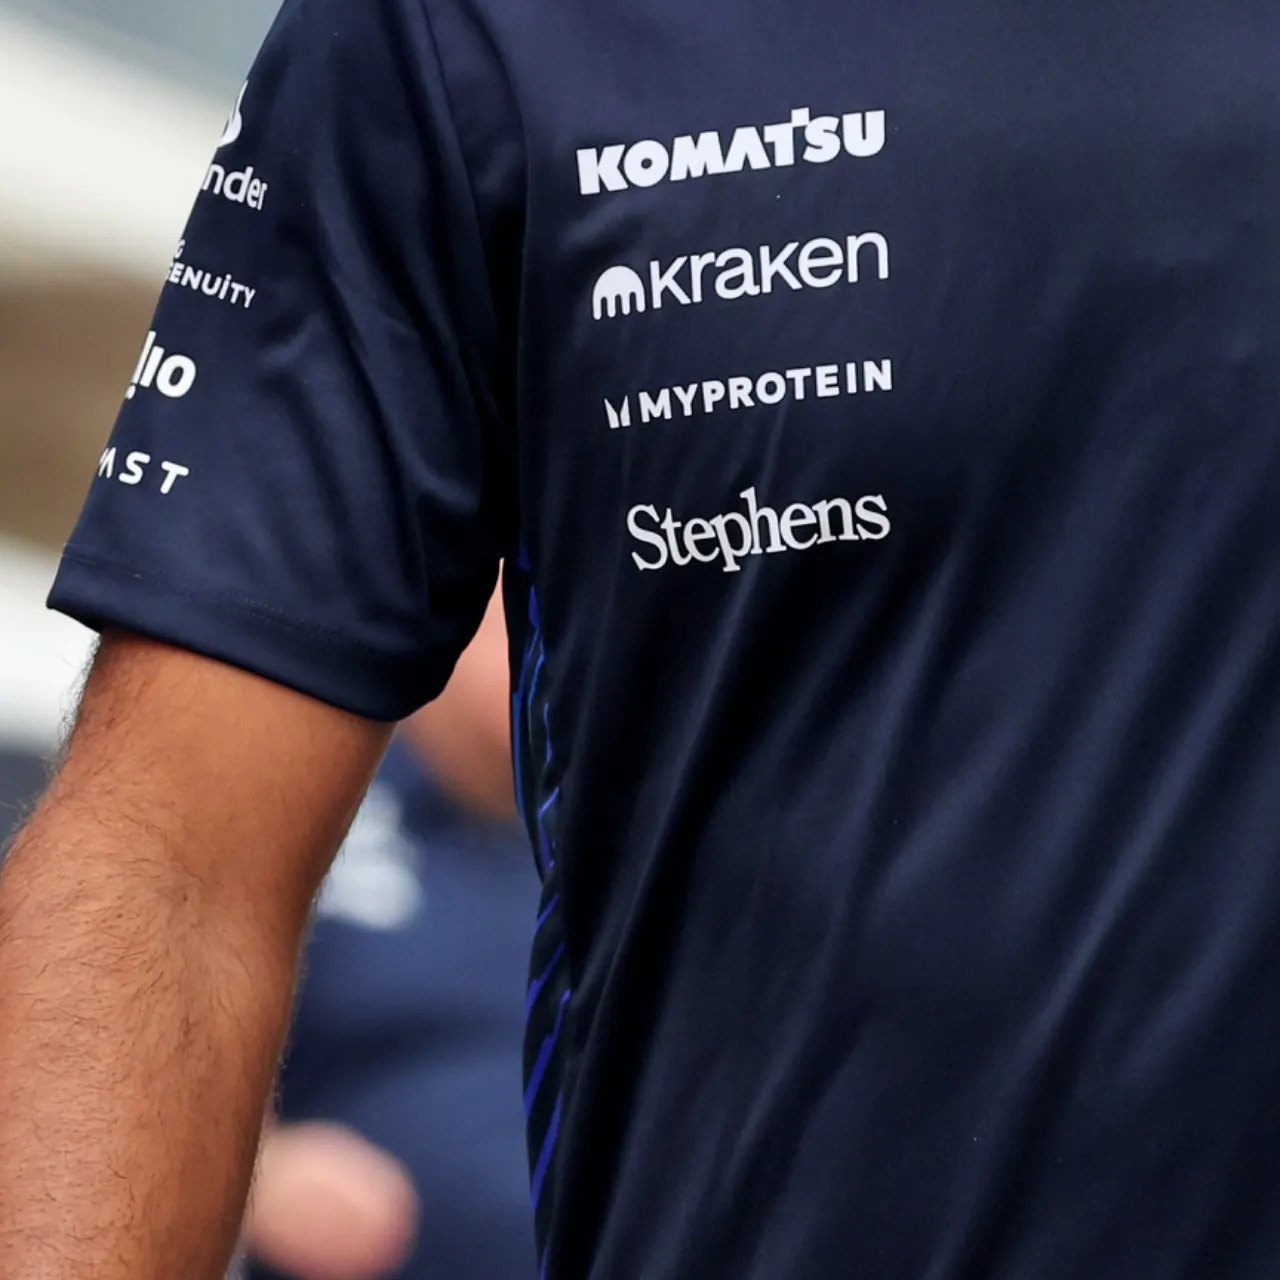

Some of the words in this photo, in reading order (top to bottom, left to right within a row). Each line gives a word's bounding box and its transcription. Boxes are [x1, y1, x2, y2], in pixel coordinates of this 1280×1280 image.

[576, 107, 886, 195] KOMATSU
[638, 359, 893, 423] MYPROTEIN
[627, 486, 891, 572] Stephens
